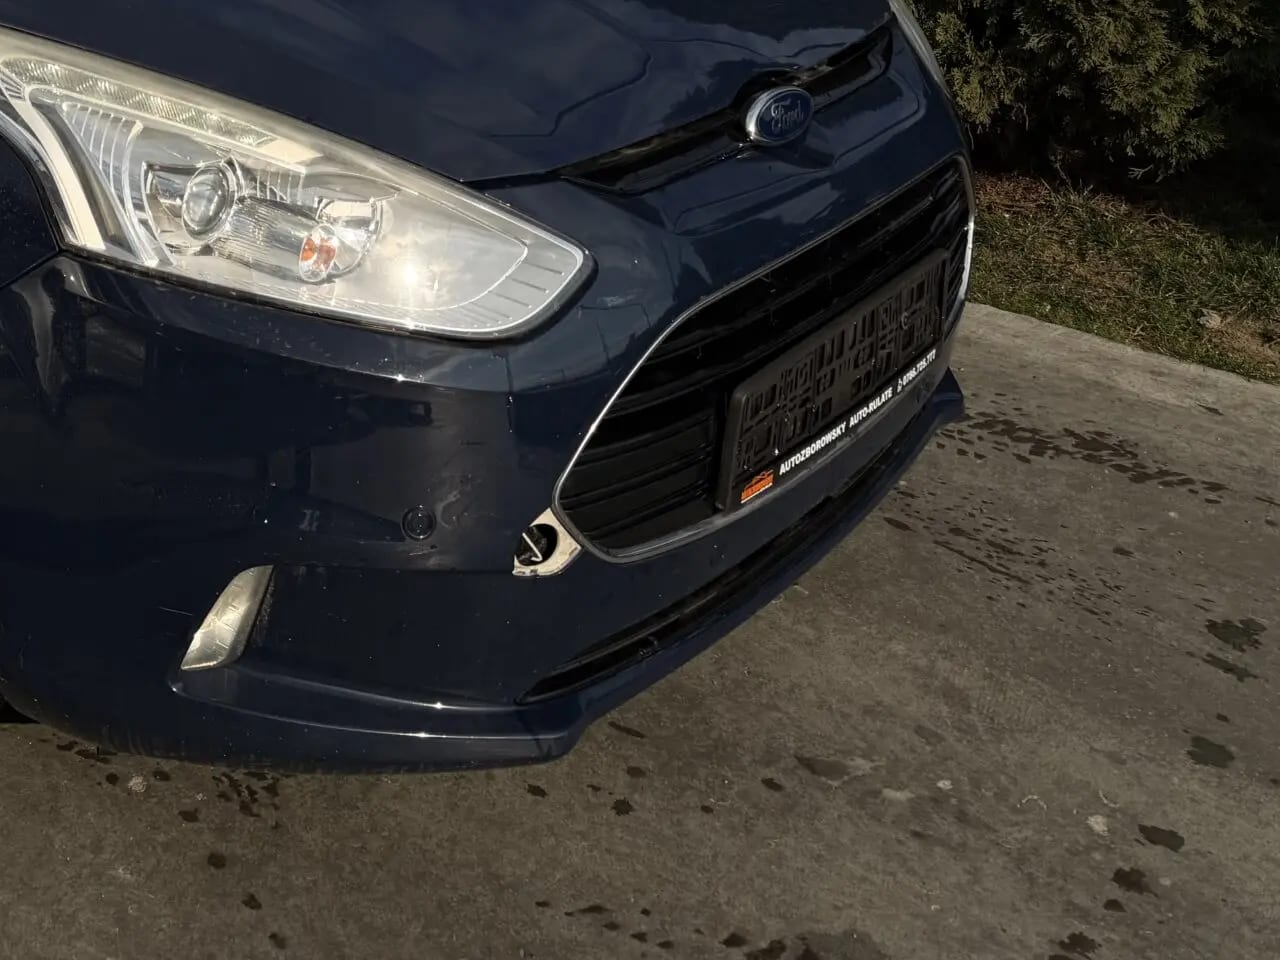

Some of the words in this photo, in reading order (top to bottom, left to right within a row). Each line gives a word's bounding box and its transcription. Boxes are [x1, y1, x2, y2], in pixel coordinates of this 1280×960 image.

[770, 98, 804, 132] Ford
[779, 421, 847, 476] AUTOZBOROWSKY
[849, 386, 893, 428] AUTO-RULATE
